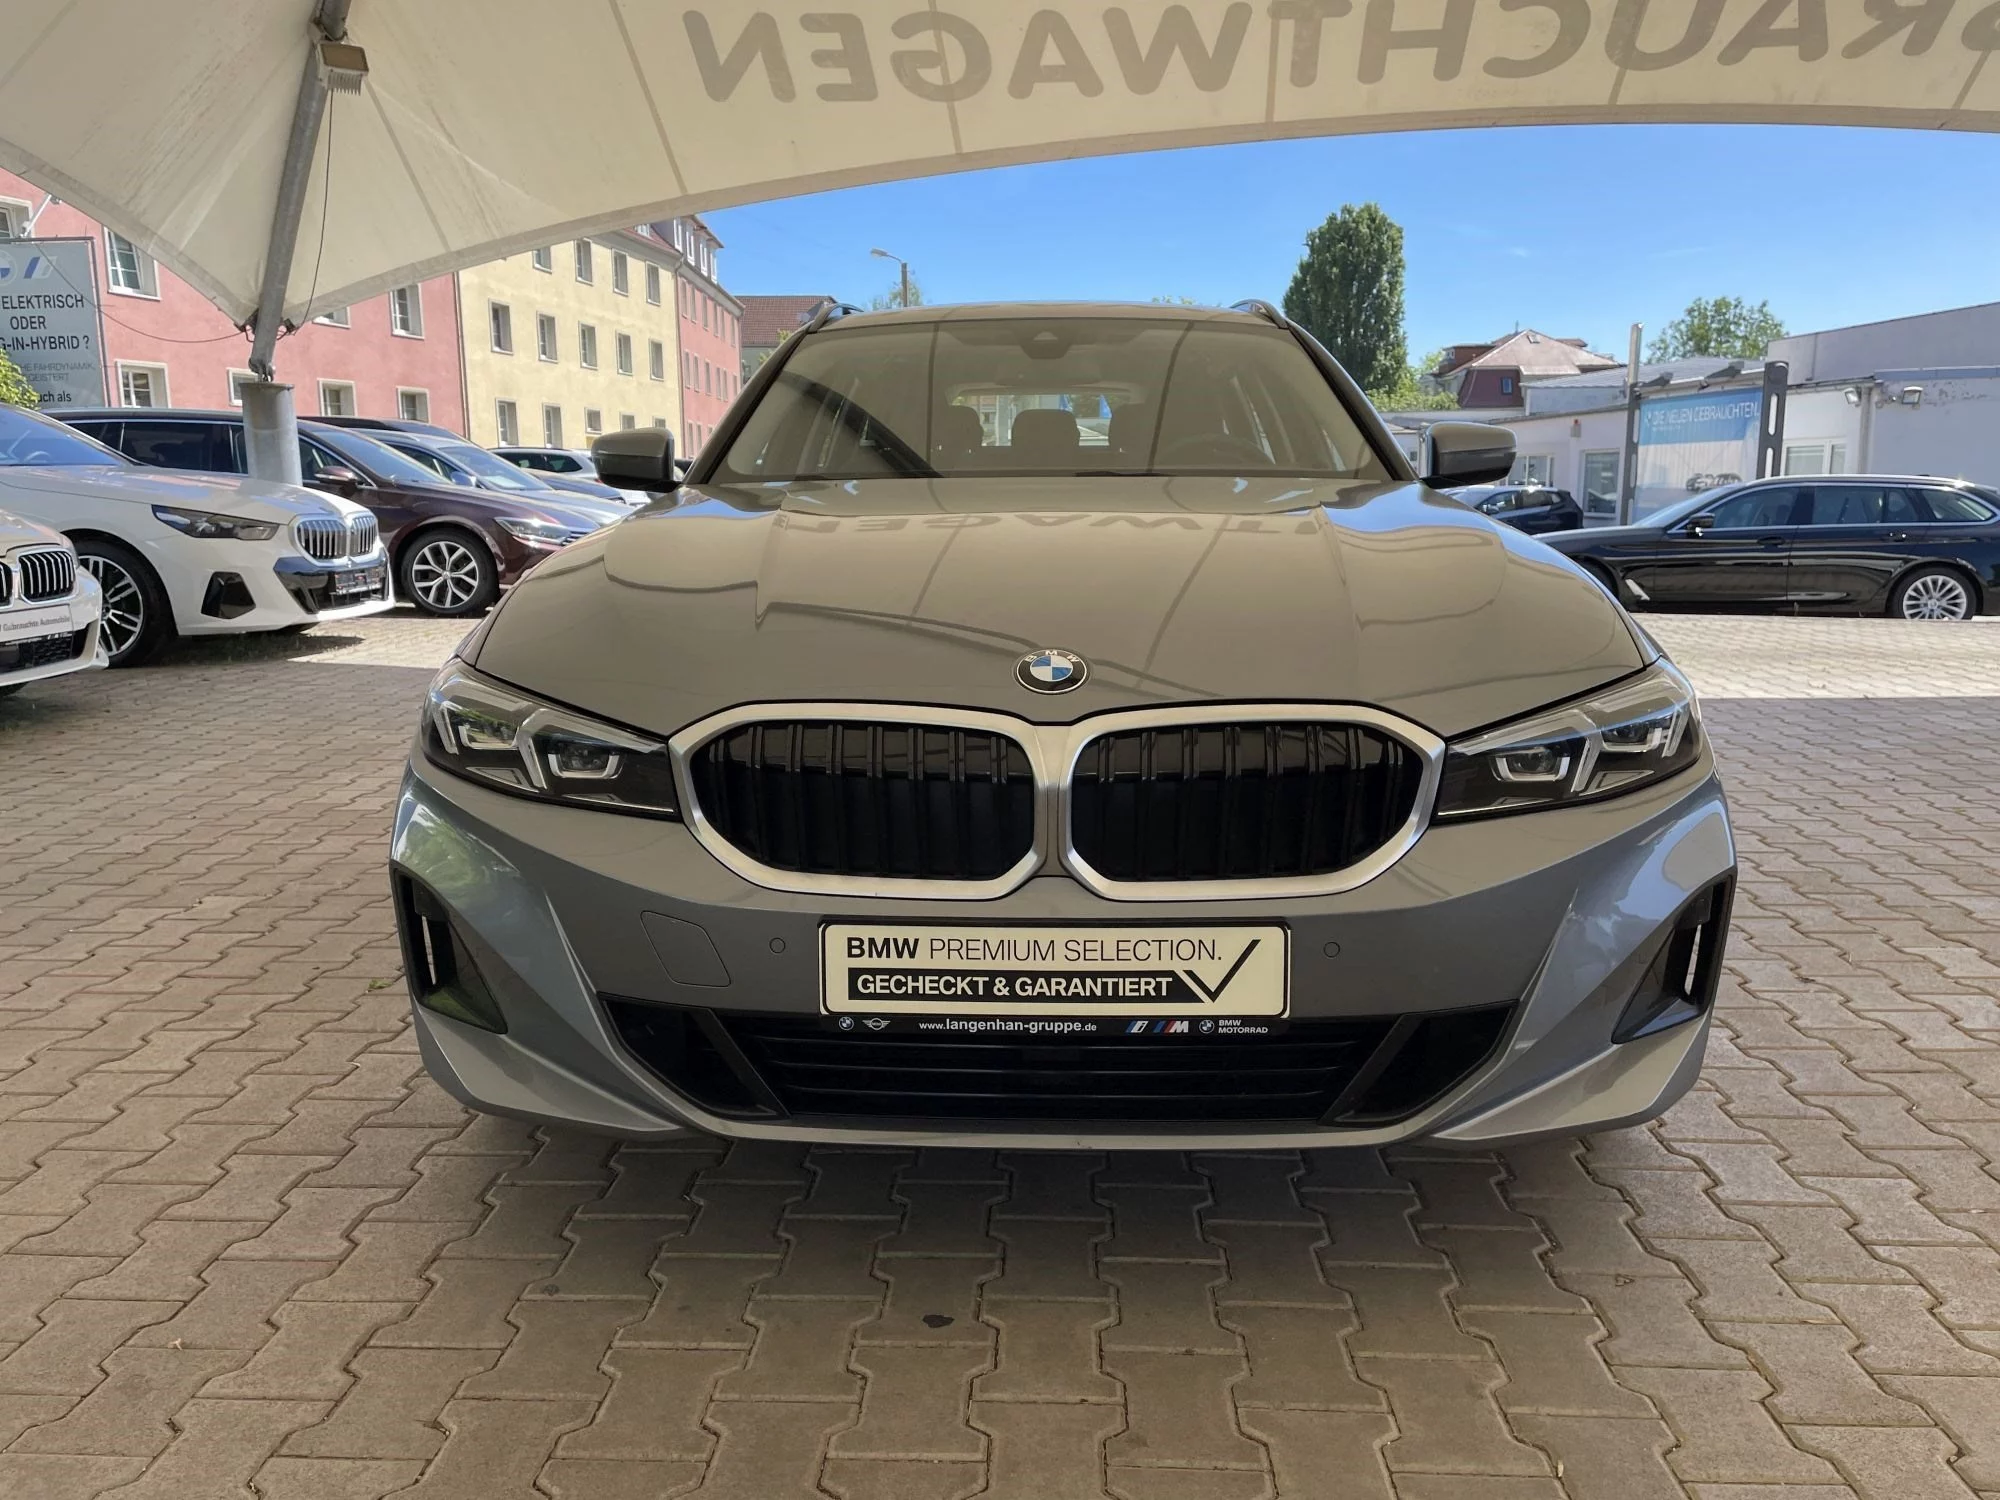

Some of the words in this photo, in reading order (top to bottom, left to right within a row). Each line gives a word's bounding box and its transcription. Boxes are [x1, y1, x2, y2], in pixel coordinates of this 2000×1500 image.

[1, 294, 85, 310] ELEKTRISCH
[10, 315, 47, 330] ODER
[57, 390, 72, 402] als
[1024, 649, 1080, 663] BMW
[846, 936, 920, 959] BMW
[930, 938, 1055, 961] PREMIUM
[1064, 938, 1222, 962] SELECTION.
[857, 974, 989, 995] GECHECKT
[993, 976, 1010, 996] &
[1015, 976, 1173, 997] GARANTIERT
[918, 1018, 1097, 1034] www.langenhan-gruppe.de
[1218, 1026, 1268, 1034] MOTORRAD
